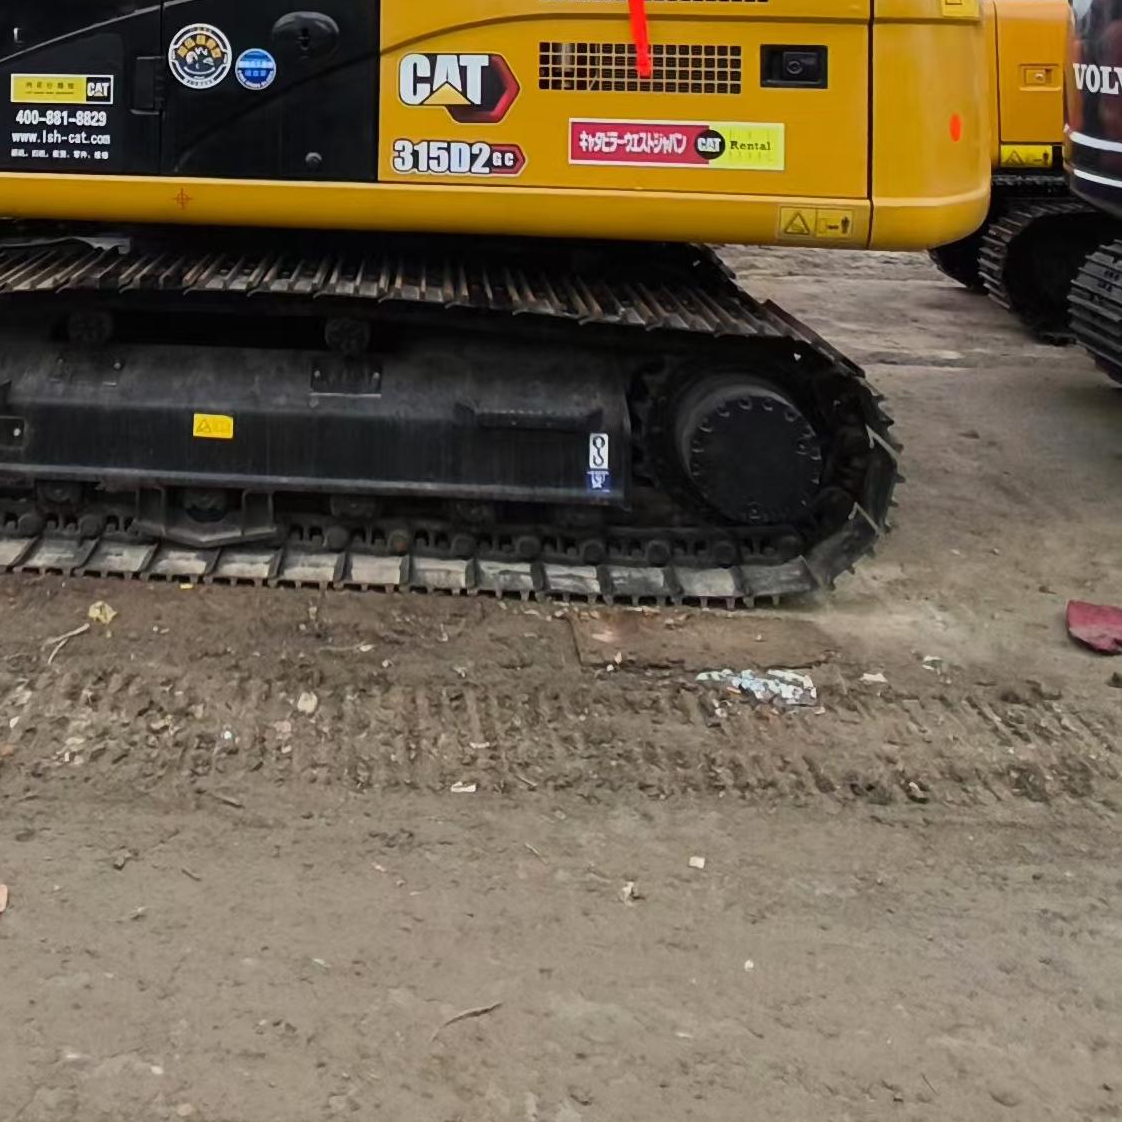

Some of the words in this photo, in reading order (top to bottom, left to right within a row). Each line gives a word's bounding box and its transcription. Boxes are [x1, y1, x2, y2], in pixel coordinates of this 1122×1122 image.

[399, 53, 489, 106] CAT
[86, 82, 110, 97] CAT
[15, 109, 107, 127] 400-881-8829
[11, 130, 111, 145] www.lsh-cat.com
[696, 137, 721, 153] CAT
[729, 140, 771, 151] Rental
[393, 139, 491, 174] 315D2
